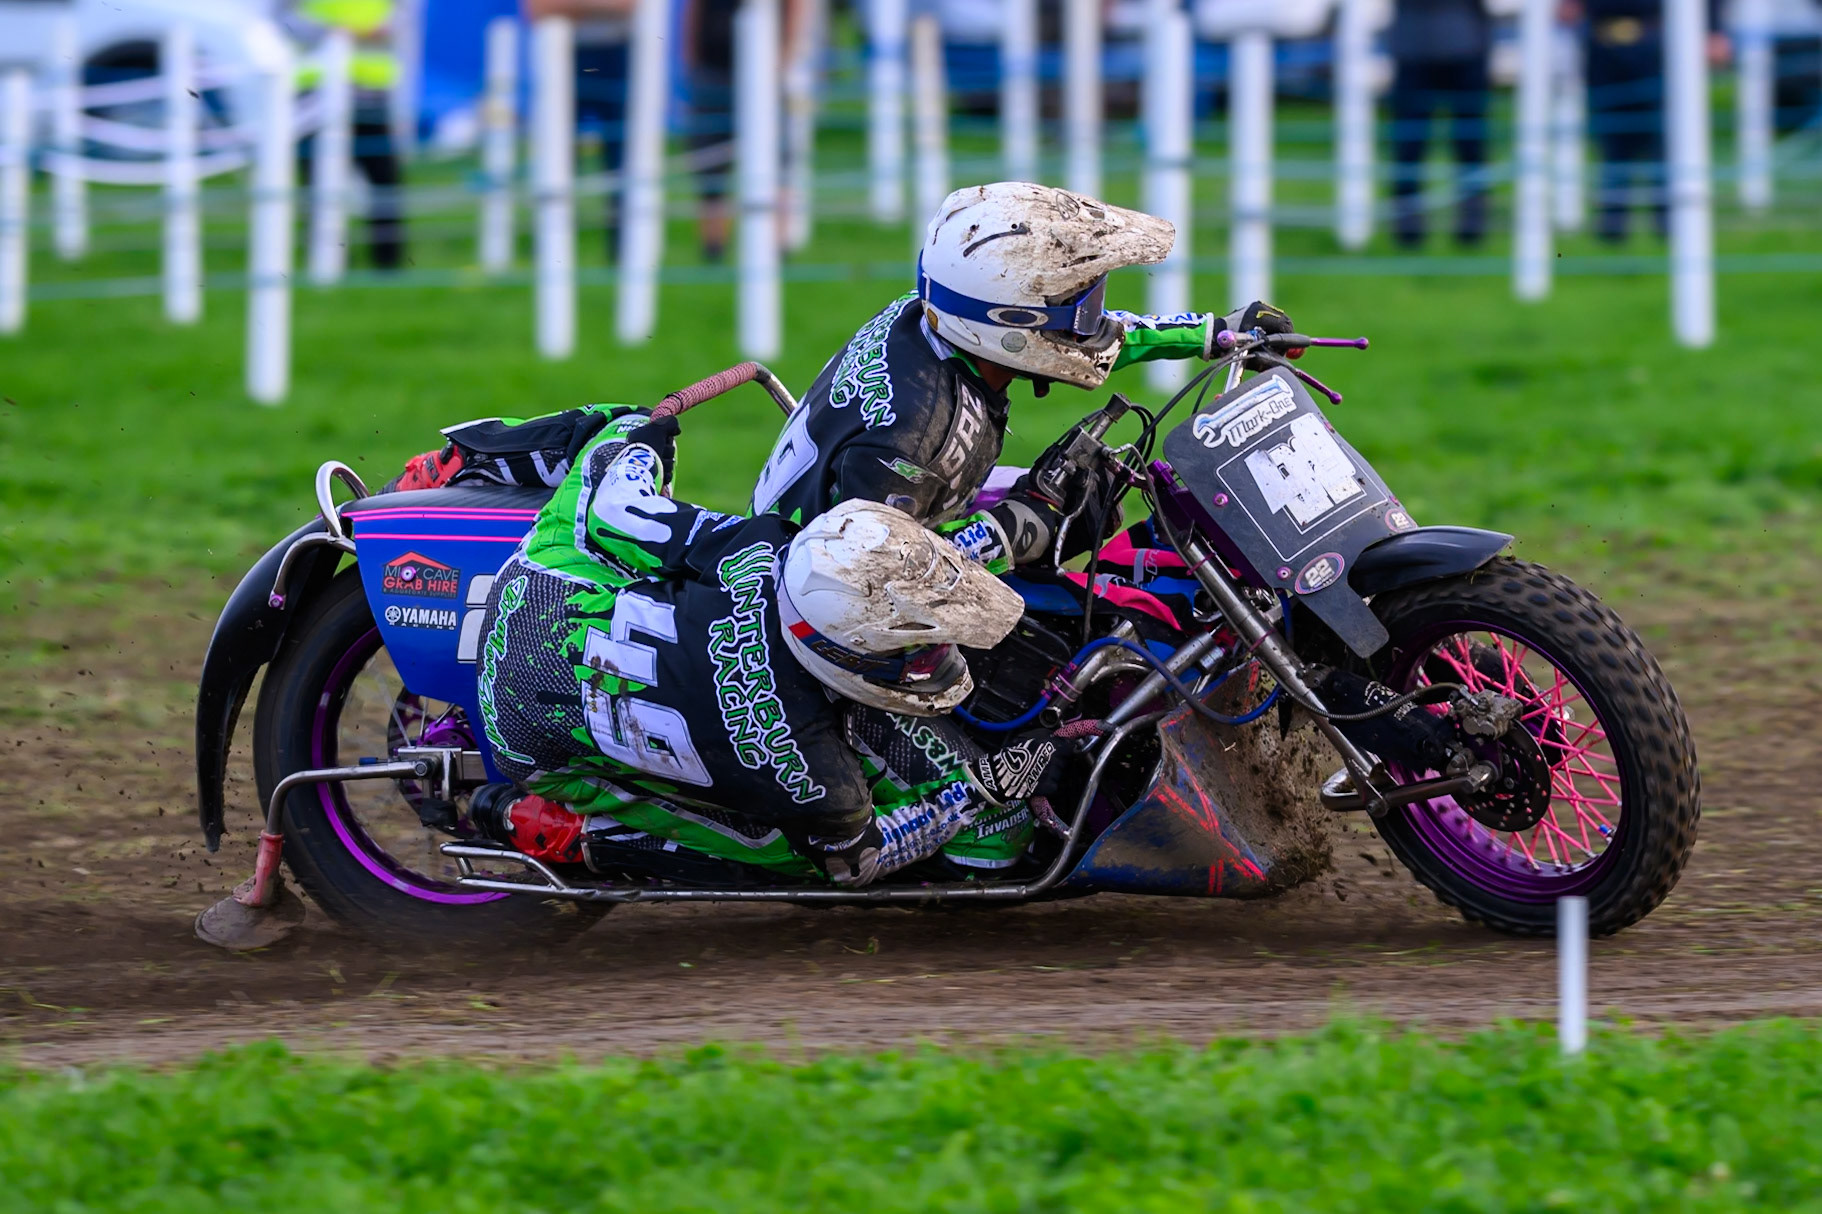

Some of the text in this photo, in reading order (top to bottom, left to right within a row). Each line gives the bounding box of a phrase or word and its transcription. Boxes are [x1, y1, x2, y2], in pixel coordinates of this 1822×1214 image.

[383, 576, 458, 594] GRAB HIRE
[384, 565, 459, 582] MIK CAVE
[401, 607, 457, 627] YAMAHA
[717, 541, 826, 804] WINTERBURN
[708, 616, 769, 770] RACING
[979, 753, 998, 792] AMPE
